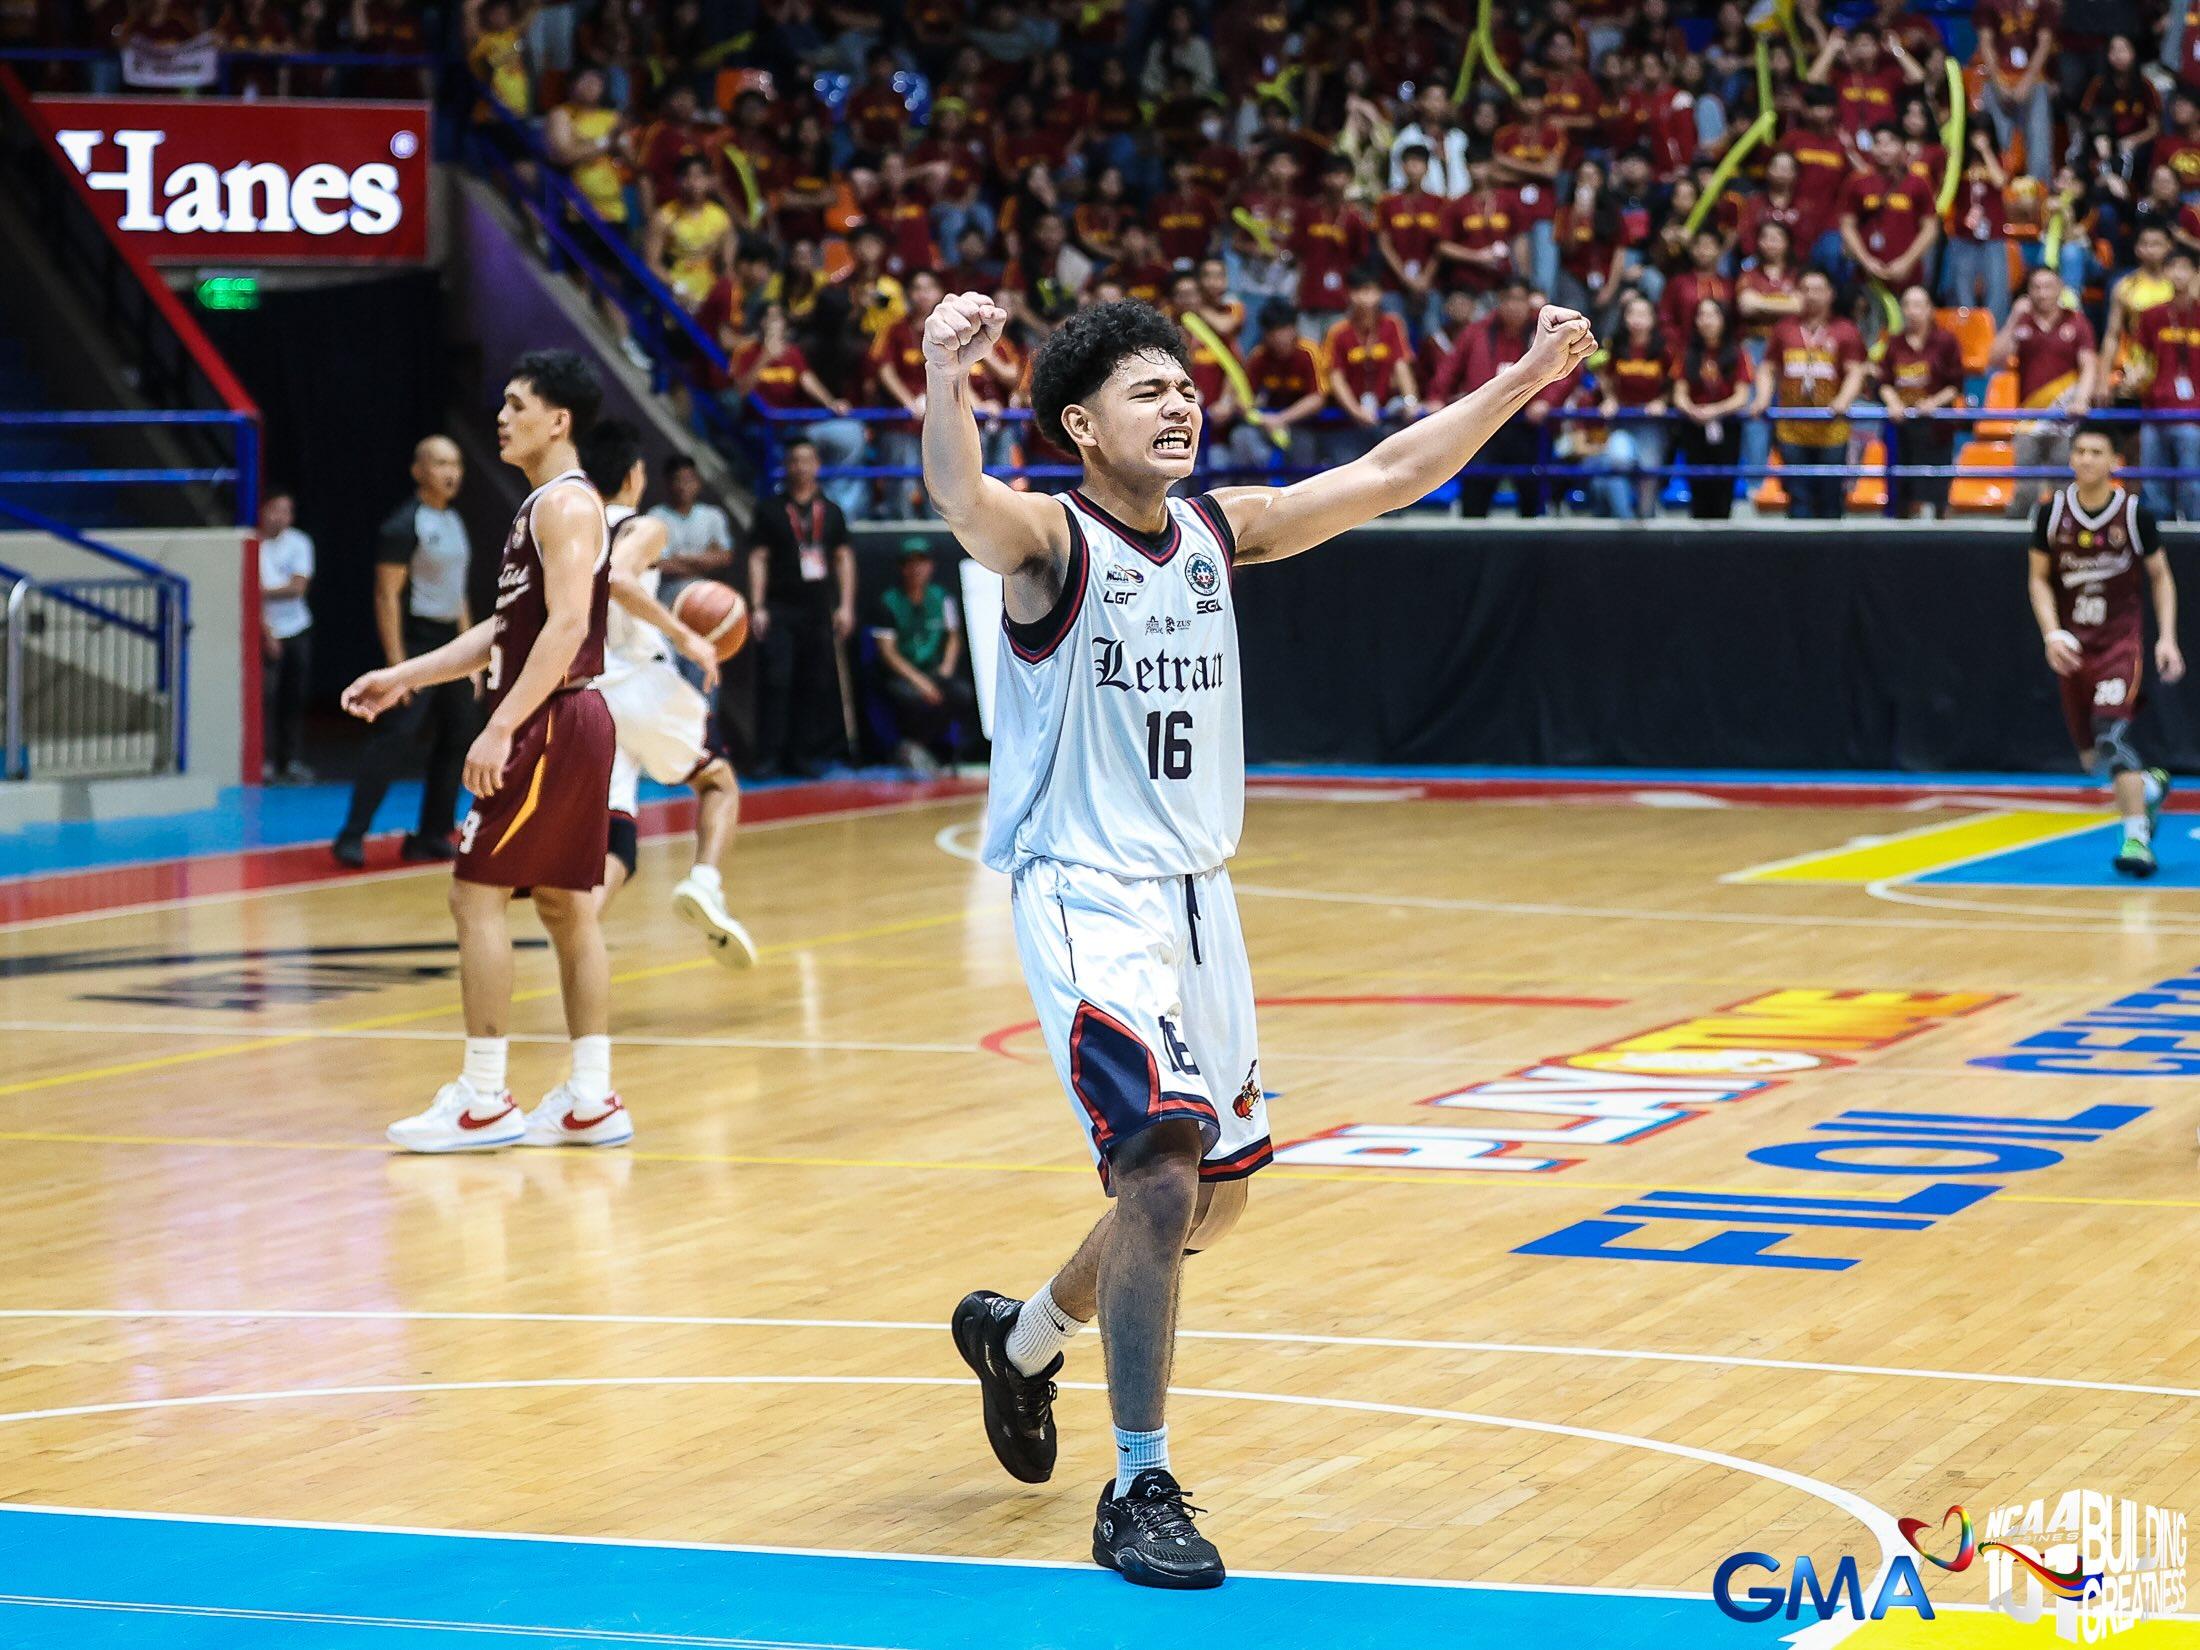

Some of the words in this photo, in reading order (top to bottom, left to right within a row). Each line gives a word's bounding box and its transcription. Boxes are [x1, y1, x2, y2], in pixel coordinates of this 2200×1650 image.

[56, 129, 403, 235] Hanes
[1091, 636, 1224, 694] Letran
[1146, 711, 1194, 780] 16
[459, 809, 482, 854] 9
[1158, 1015, 1200, 1075] 16
[1508, 1104, 2156, 1272] FILOIL
